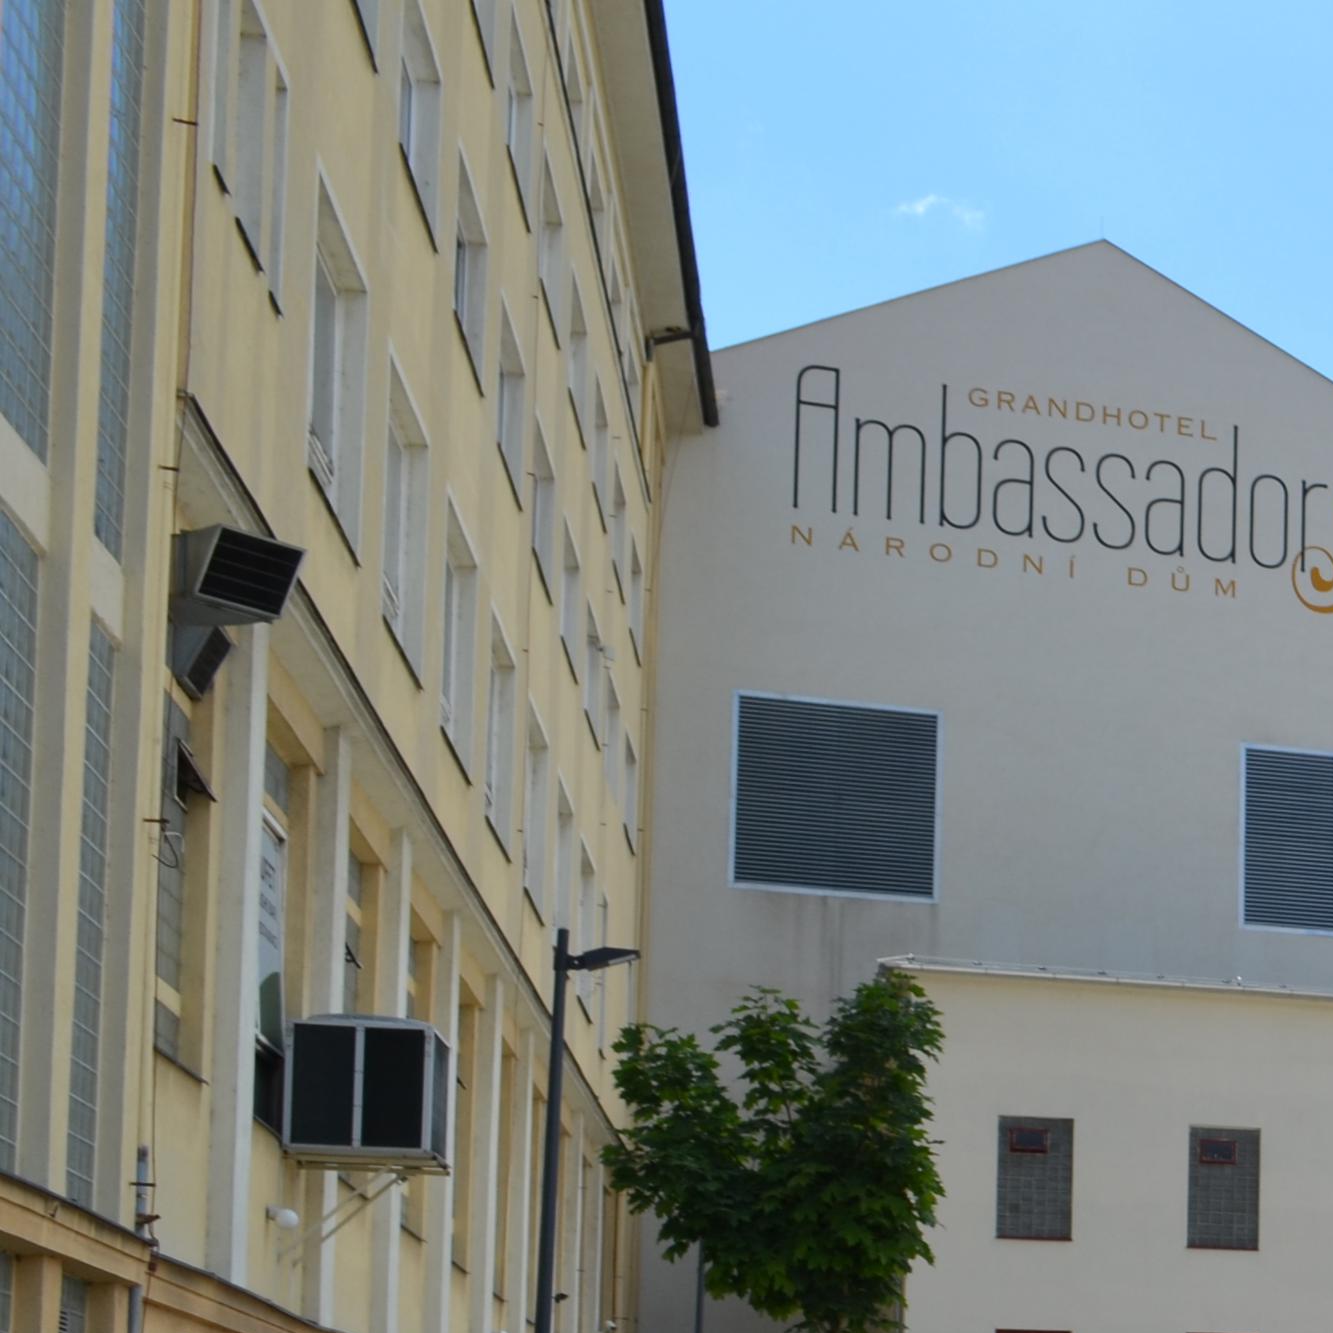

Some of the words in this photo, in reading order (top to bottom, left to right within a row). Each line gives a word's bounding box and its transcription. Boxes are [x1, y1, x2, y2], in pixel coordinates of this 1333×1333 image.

[967, 387, 1218, 441] GRANDHOTEL
[792, 364, 1328, 573] Ambassador
[790, 525, 1076, 579] NÁRODNÍ
[1126, 566, 1237, 599] DŮM
